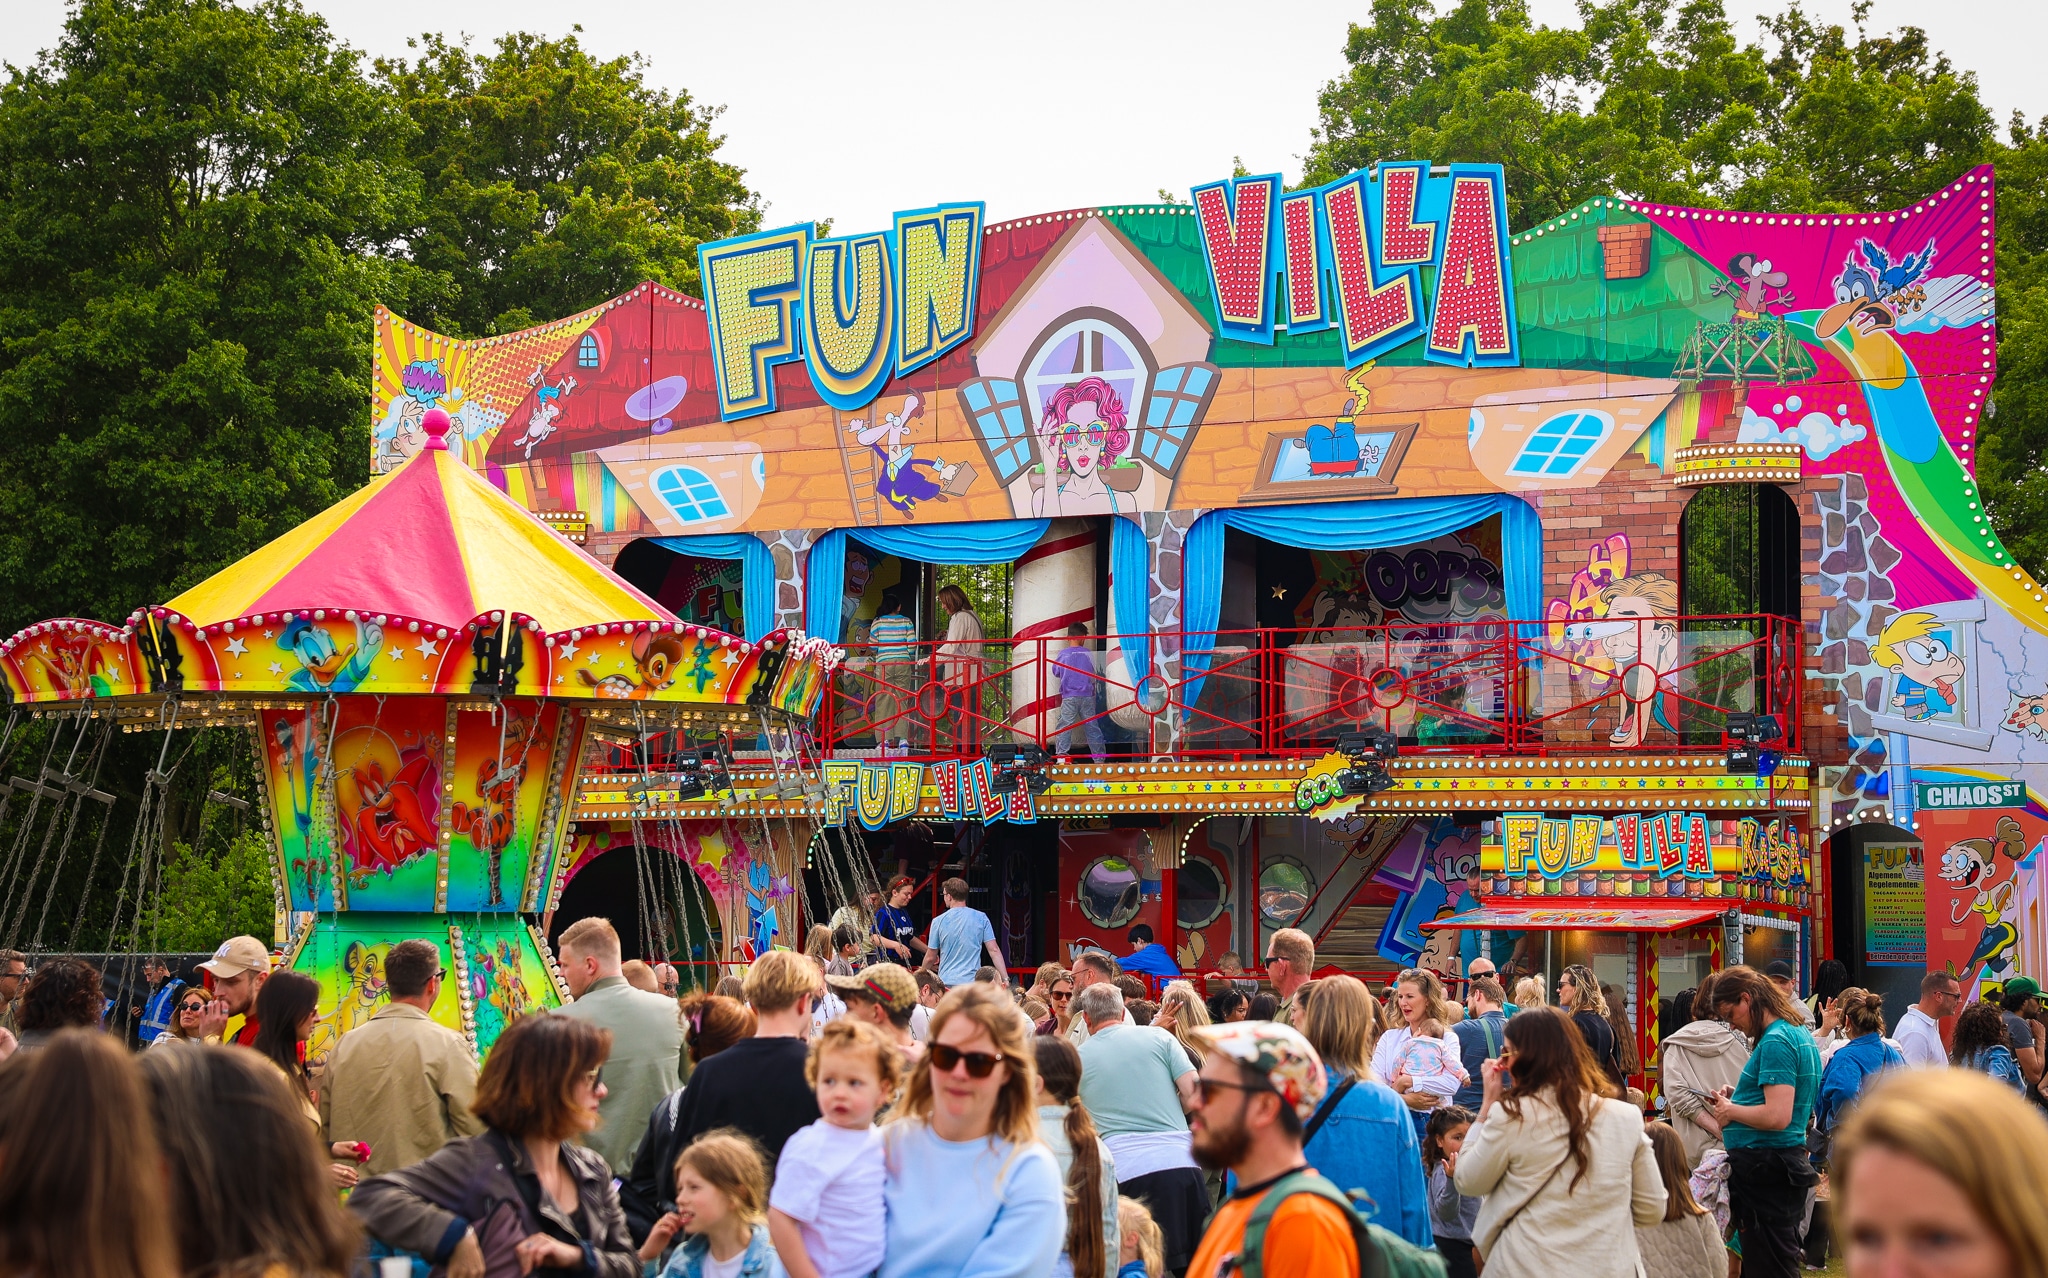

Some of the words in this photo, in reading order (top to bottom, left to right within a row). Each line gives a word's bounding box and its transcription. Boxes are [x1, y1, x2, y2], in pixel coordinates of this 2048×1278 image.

[699, 203, 984, 420] FUN
[1192, 163, 1516, 366] VILLA
[822, 760, 924, 831] FUN
[931, 757, 1037, 827] VILA
[1927, 785, 2003, 806] CHAOS
[2002, 784, 2021, 796] ST
[1504, 812, 1603, 878] FUN
[1613, 811, 1714, 878] VILLA
[1740, 816, 1806, 890] KASSA
[1868, 846, 1907, 870] FUN
[1443, 854, 1481, 881] LO
[1868, 871, 1902, 880] Algemene
[1868, 880, 1920, 888] Regelementen:
